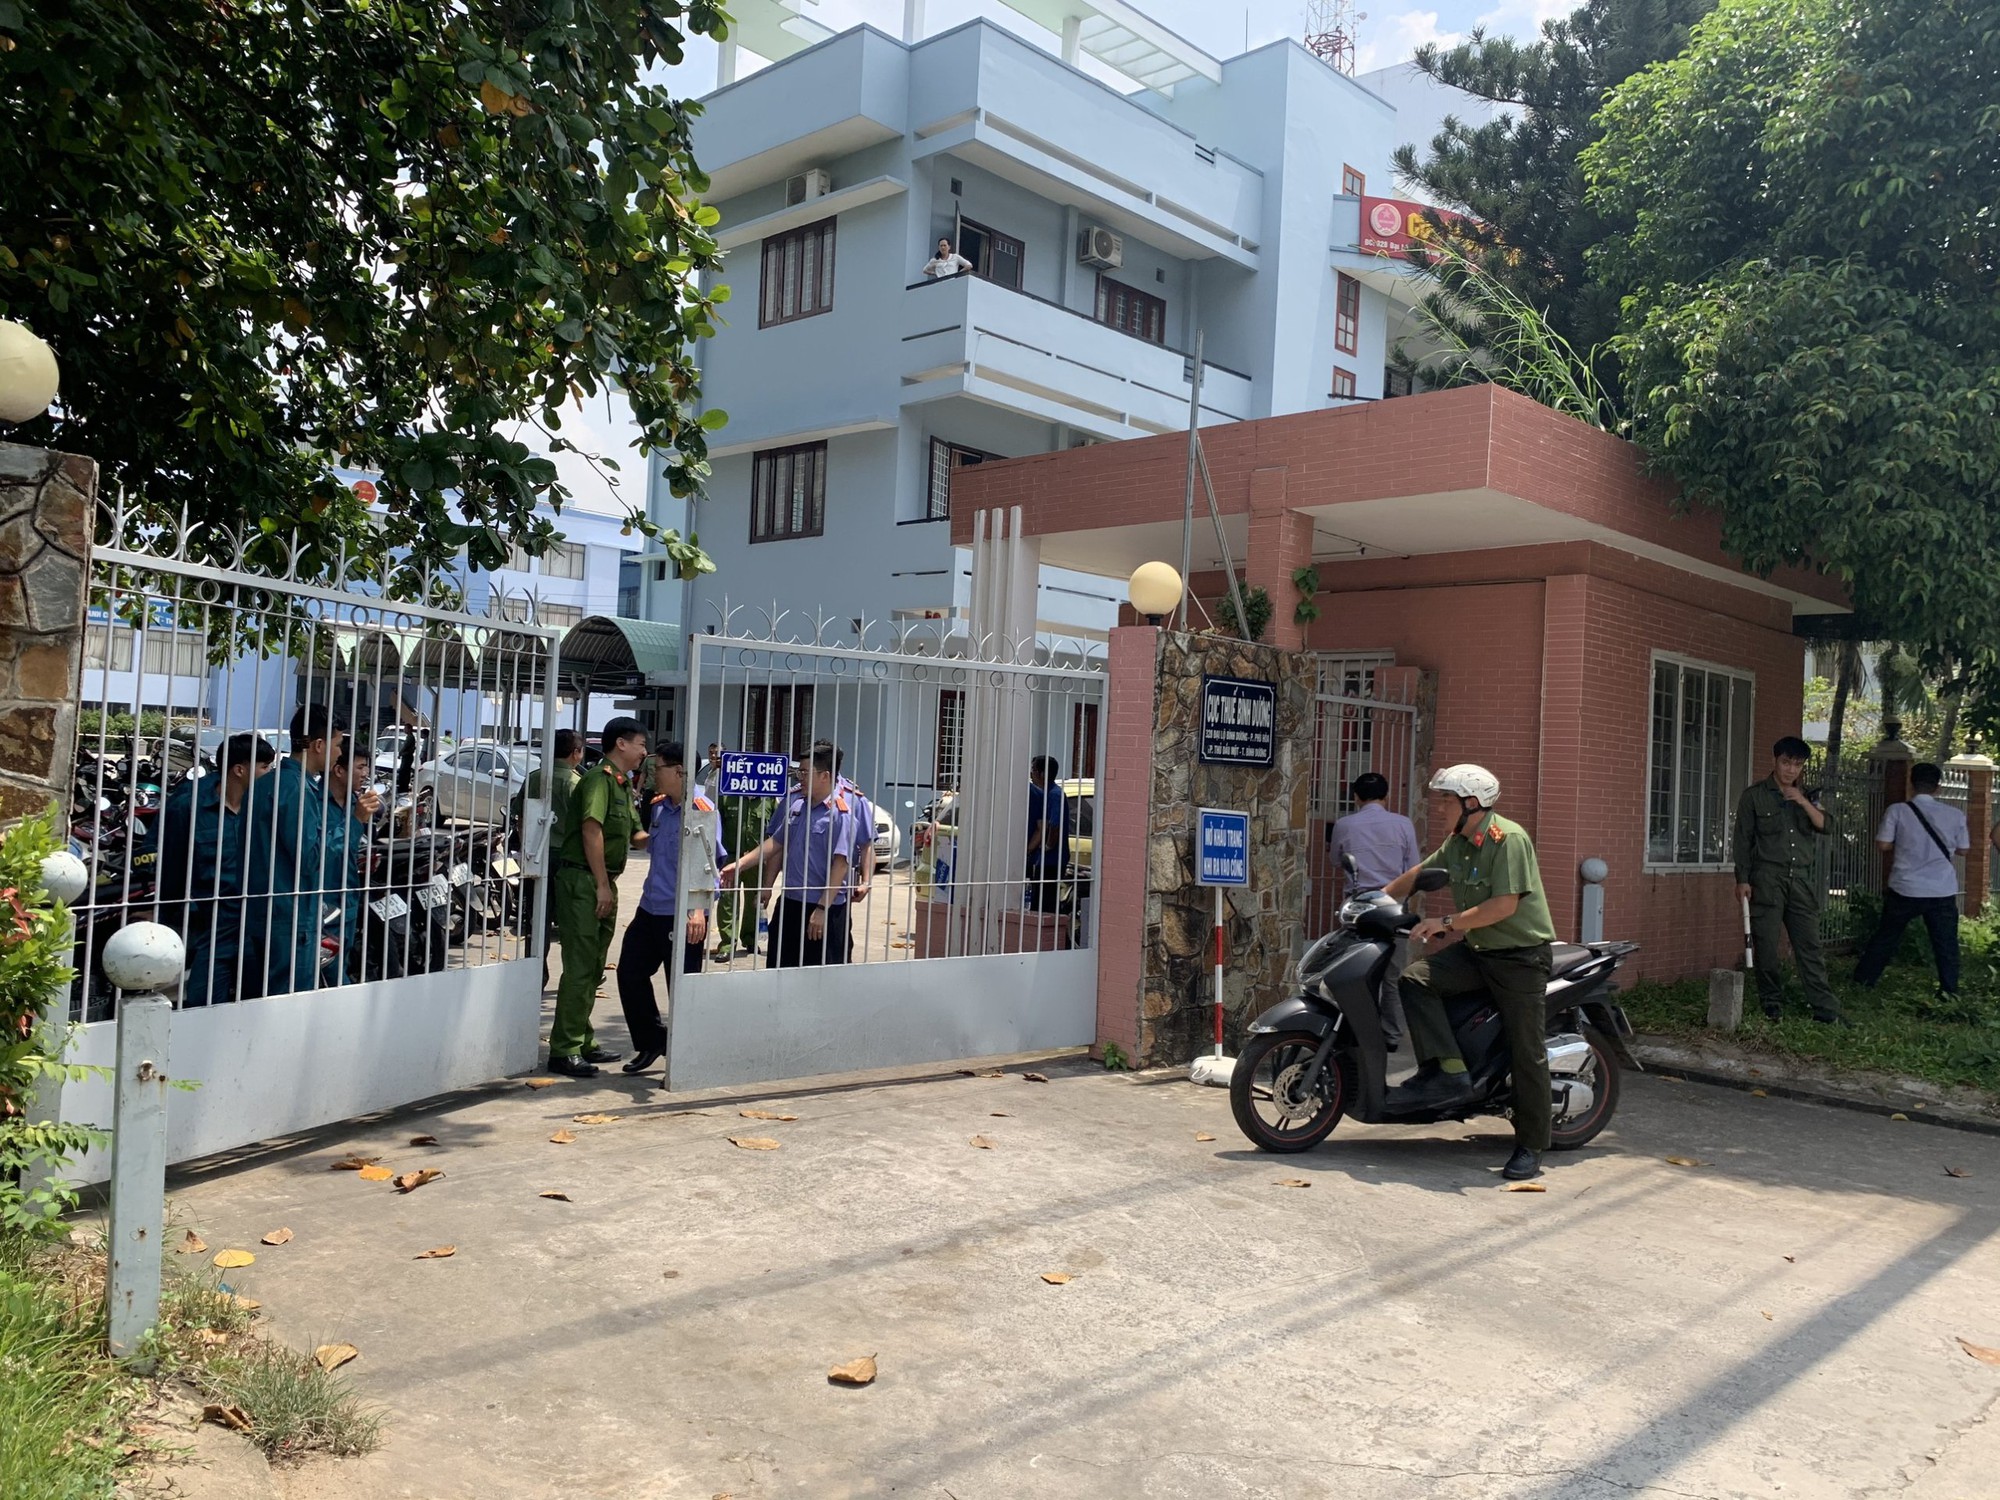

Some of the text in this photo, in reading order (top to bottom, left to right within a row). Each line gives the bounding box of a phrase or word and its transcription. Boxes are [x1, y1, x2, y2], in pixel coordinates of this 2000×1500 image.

[1220, 686, 1238, 725] THUẾ
[1237, 691, 1252, 726] BÌNH
[726, 757, 783, 775] HẾT CHỖ
[730, 775, 778, 792] ĐẬU XE
[1227, 829, 1243, 849] TRANG
[133, 852, 159, 867] DQT
[1203, 857, 1213, 876] KHI
[1212, 857, 1220, 876] RA
[1230, 849, 1243, 877] CỔNG
